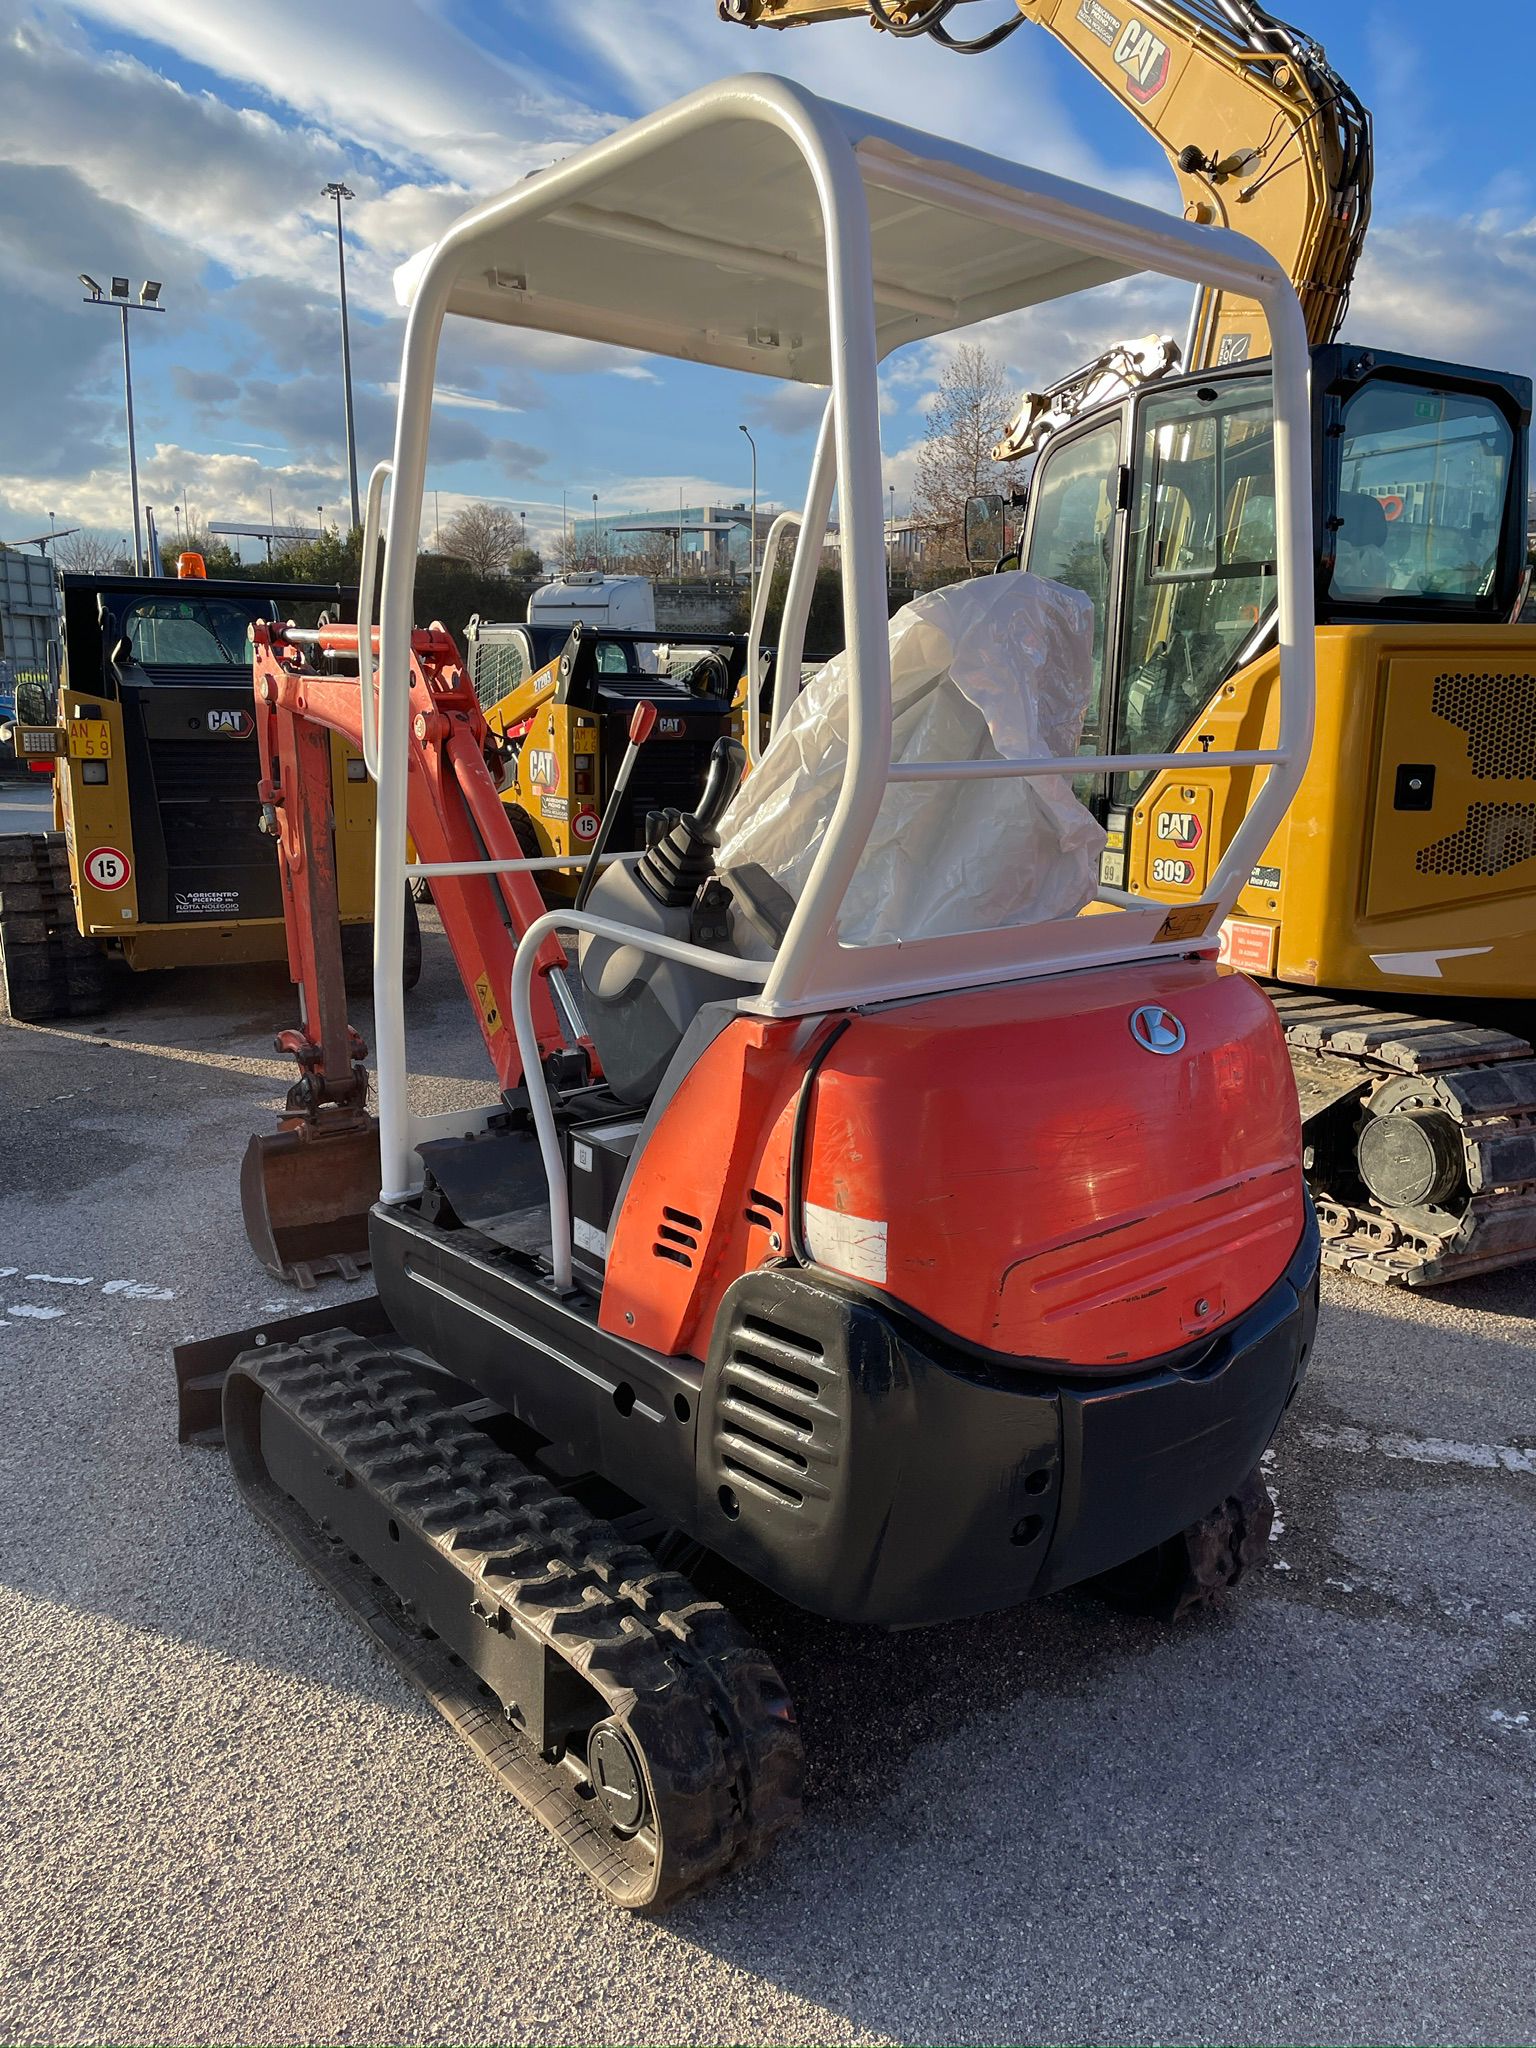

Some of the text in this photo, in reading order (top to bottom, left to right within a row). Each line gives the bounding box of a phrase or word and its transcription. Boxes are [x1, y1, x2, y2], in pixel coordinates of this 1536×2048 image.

[1114, 19, 1166, 85] CAT
[70, 723, 108, 738] AN A
[207, 711, 242, 731] CAT
[660, 718, 680, 732] CAT
[529, 750, 553, 784] CAT
[581, 820, 594, 831] 15
[1158, 813, 1192, 841] CAT
[98, 860, 117, 878] 15
[1153, 859, 1186, 883] 309
